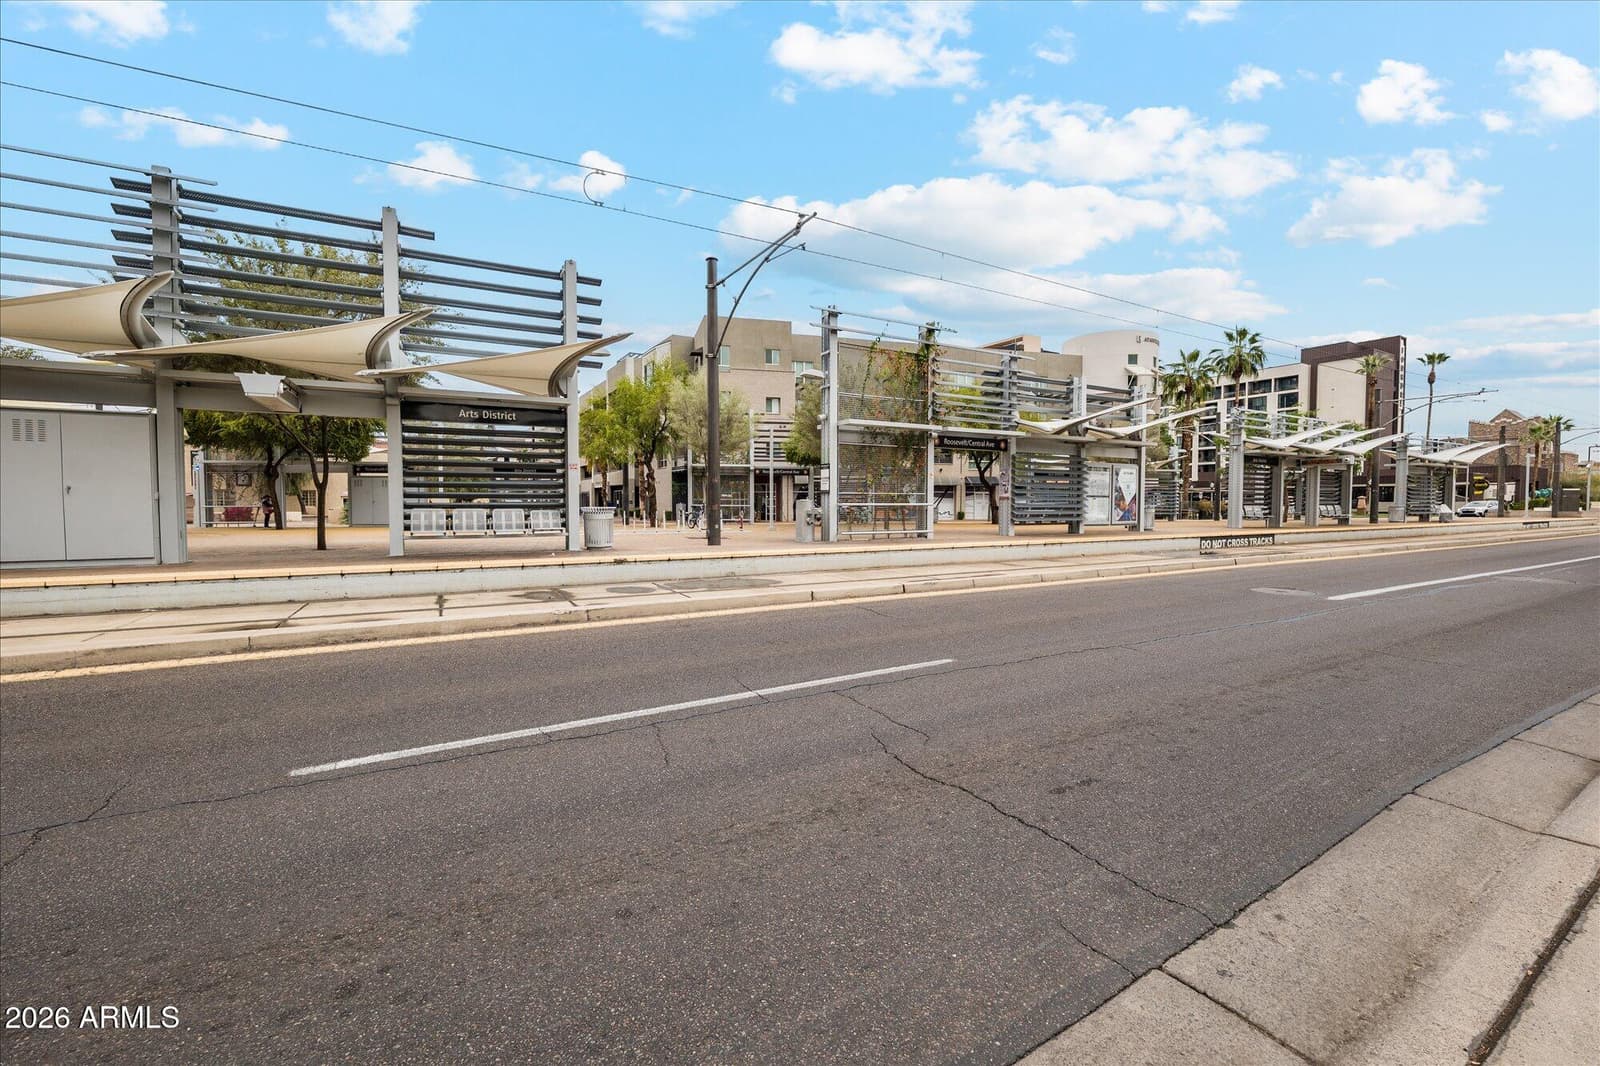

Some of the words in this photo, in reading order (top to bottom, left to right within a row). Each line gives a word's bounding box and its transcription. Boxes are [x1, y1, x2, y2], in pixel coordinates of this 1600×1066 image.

[459, 409, 479, 418] Arts
[482, 410, 516, 420] District
[1201, 540, 1211, 549] DO
[1212, 539, 1226, 549] NOT
[1227, 538, 1248, 547] CROSS
[1249, 536, 1273, 546] TRACKS
